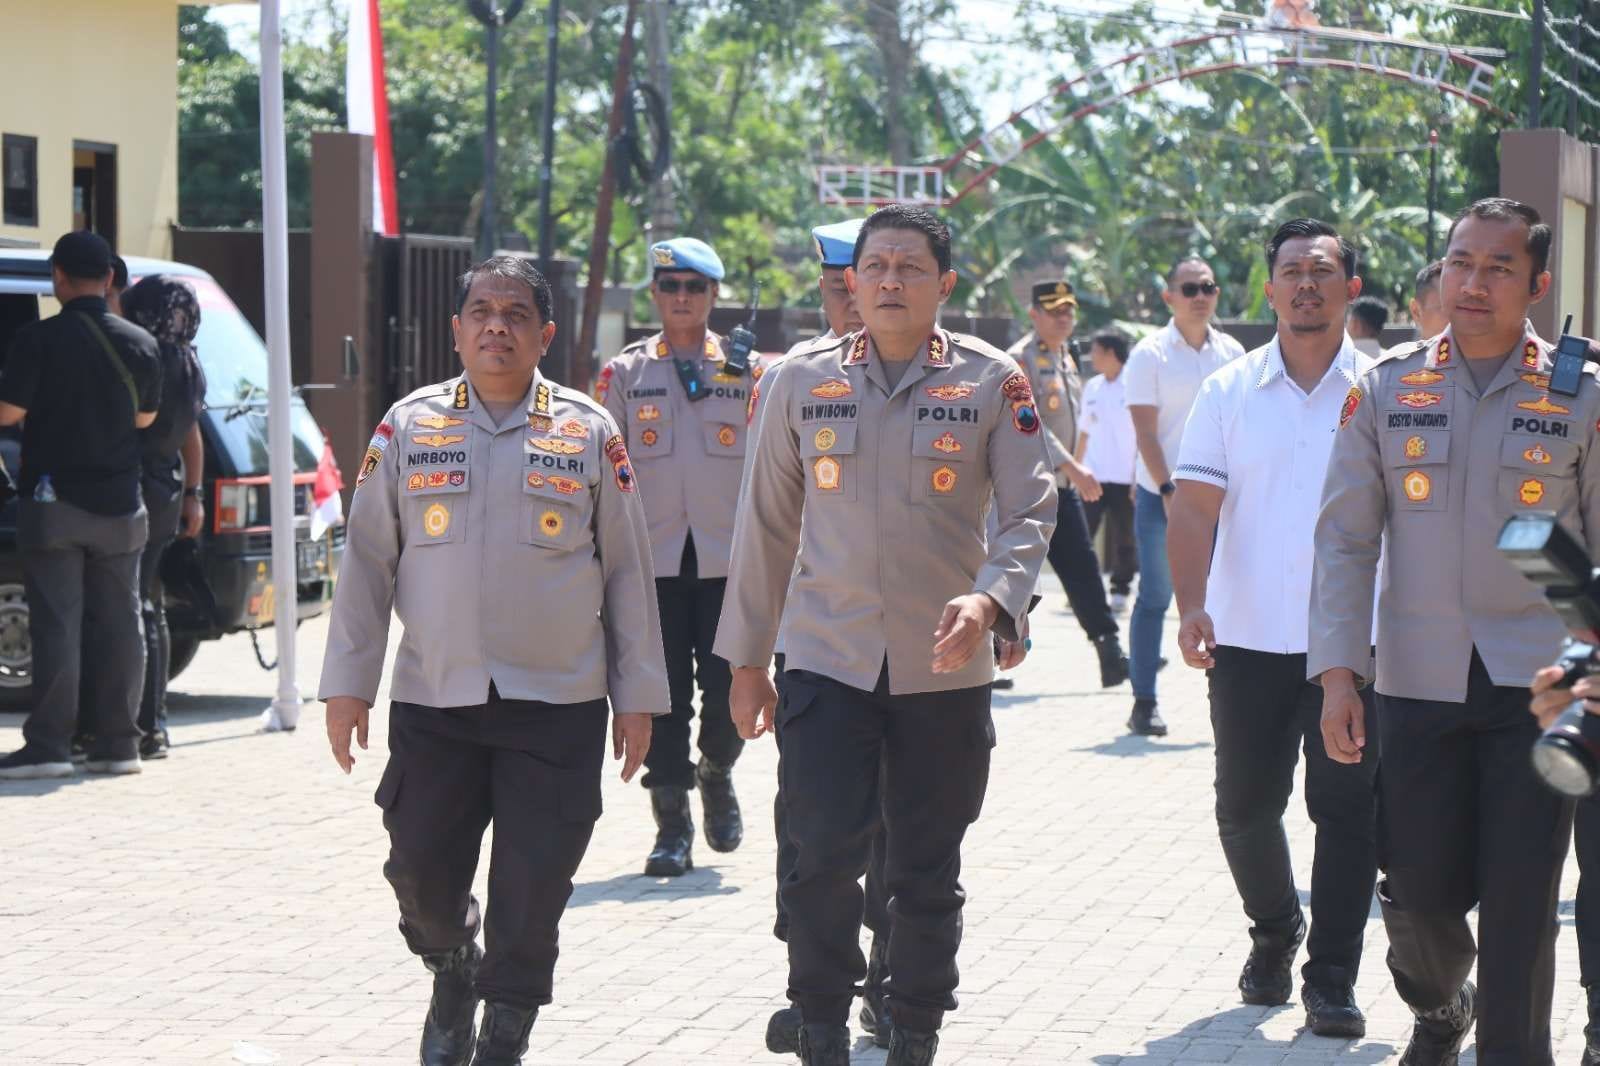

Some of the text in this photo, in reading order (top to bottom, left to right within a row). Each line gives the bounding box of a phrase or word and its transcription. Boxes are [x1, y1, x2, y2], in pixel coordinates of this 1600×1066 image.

[704, 387, 745, 399] POLRI
[815, 403, 857, 418] WIBOWO
[918, 407, 978, 423] POLRI
[1512, 417, 1569, 438] POLRI
[407, 451, 466, 466] NIRBOYO
[529, 454, 584, 474] POLRI
